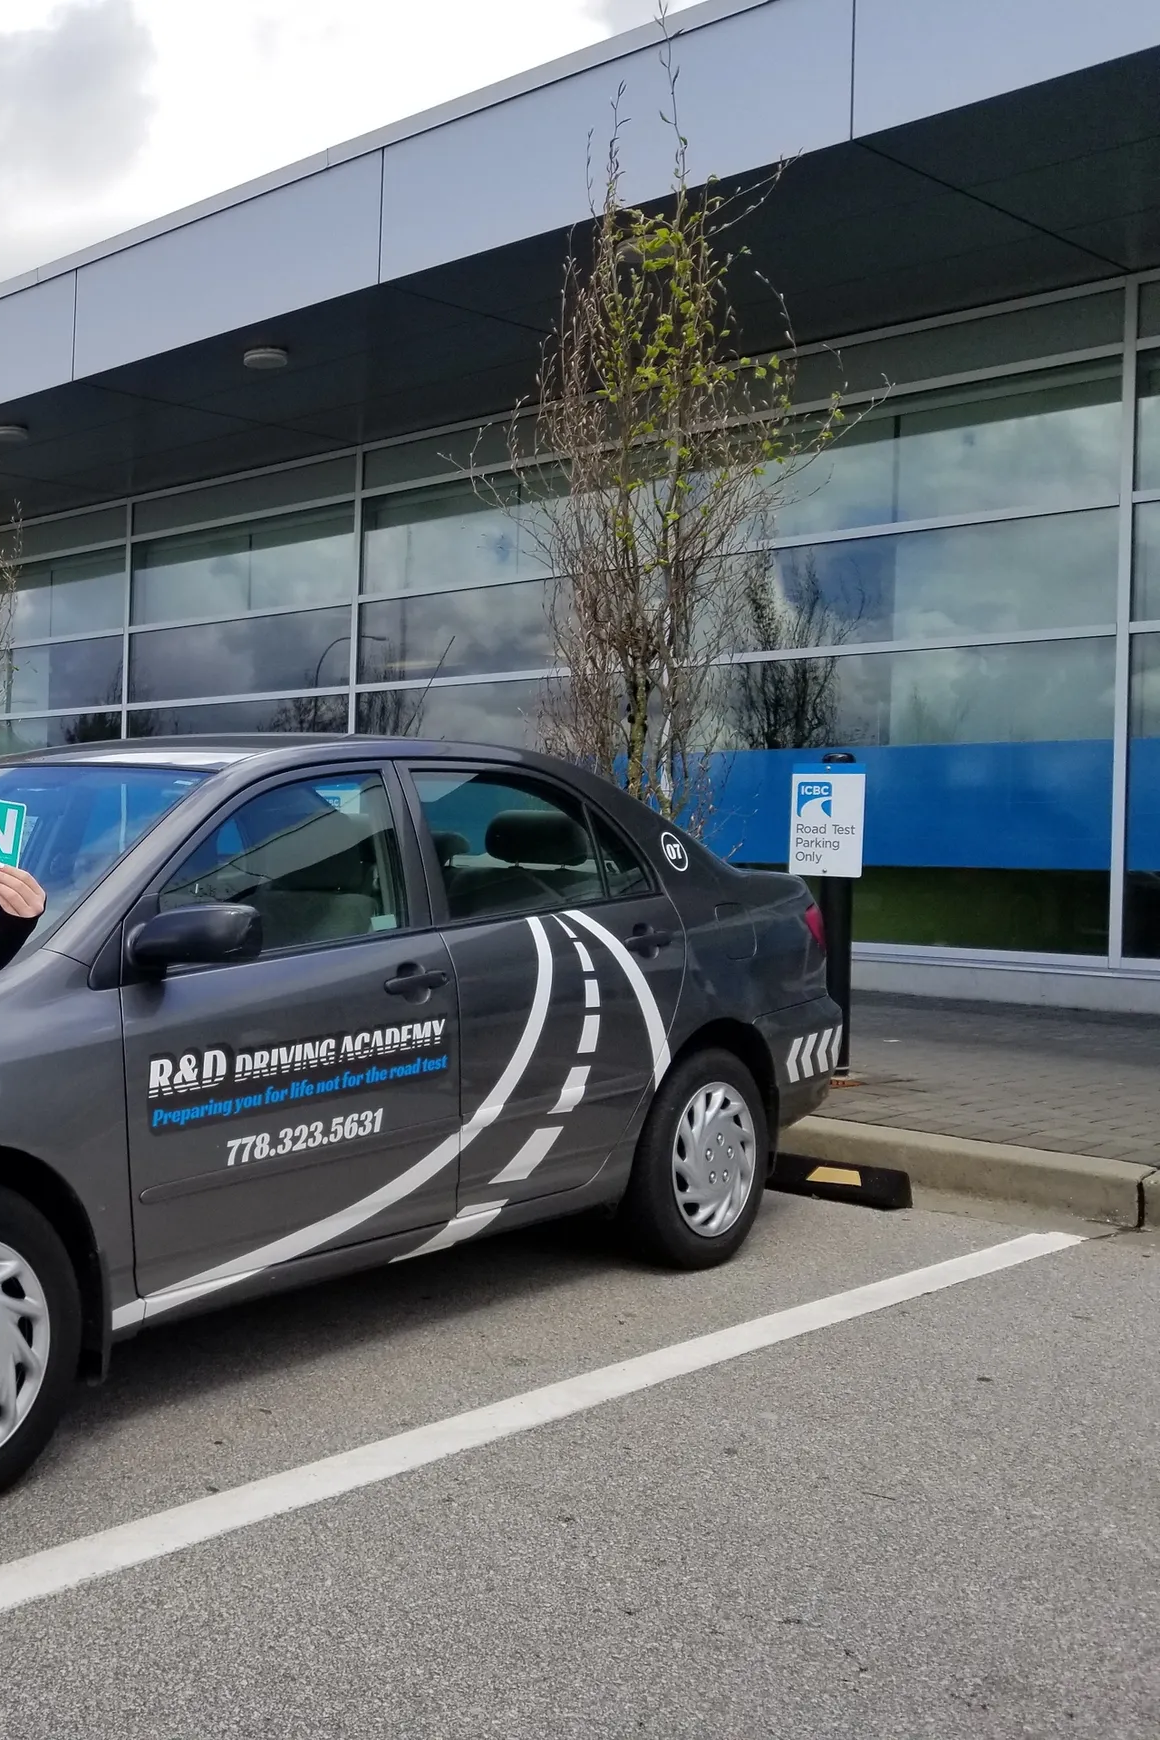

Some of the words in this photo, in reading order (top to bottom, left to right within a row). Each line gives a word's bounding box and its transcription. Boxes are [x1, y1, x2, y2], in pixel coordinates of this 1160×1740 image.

[801, 785, 829, 795] ICBC
[796, 824, 826, 834] Road
[832, 824, 856, 835] Test
[796, 837, 840, 850] Parking
[666, 843, 682, 860] 07
[795, 851, 822, 864] Only
[149, 1049, 227, 1098] R&D
[234, 1039, 336, 1082] DRIVING
[339, 1019, 445, 1062] ACADEMY
[152, 1098, 233, 1127] Preparing
[233, 1094, 262, 1114] you
[265, 1086, 288, 1105] for
[290, 1078, 314, 1100] life
[316, 1076, 340, 1093] not
[342, 1071, 364, 1088] for
[366, 1066, 391, 1084] the
[389, 1058, 420, 1079] road
[423, 1054, 448, 1071] test
[227, 1108, 384, 1166] 778.323.5631
